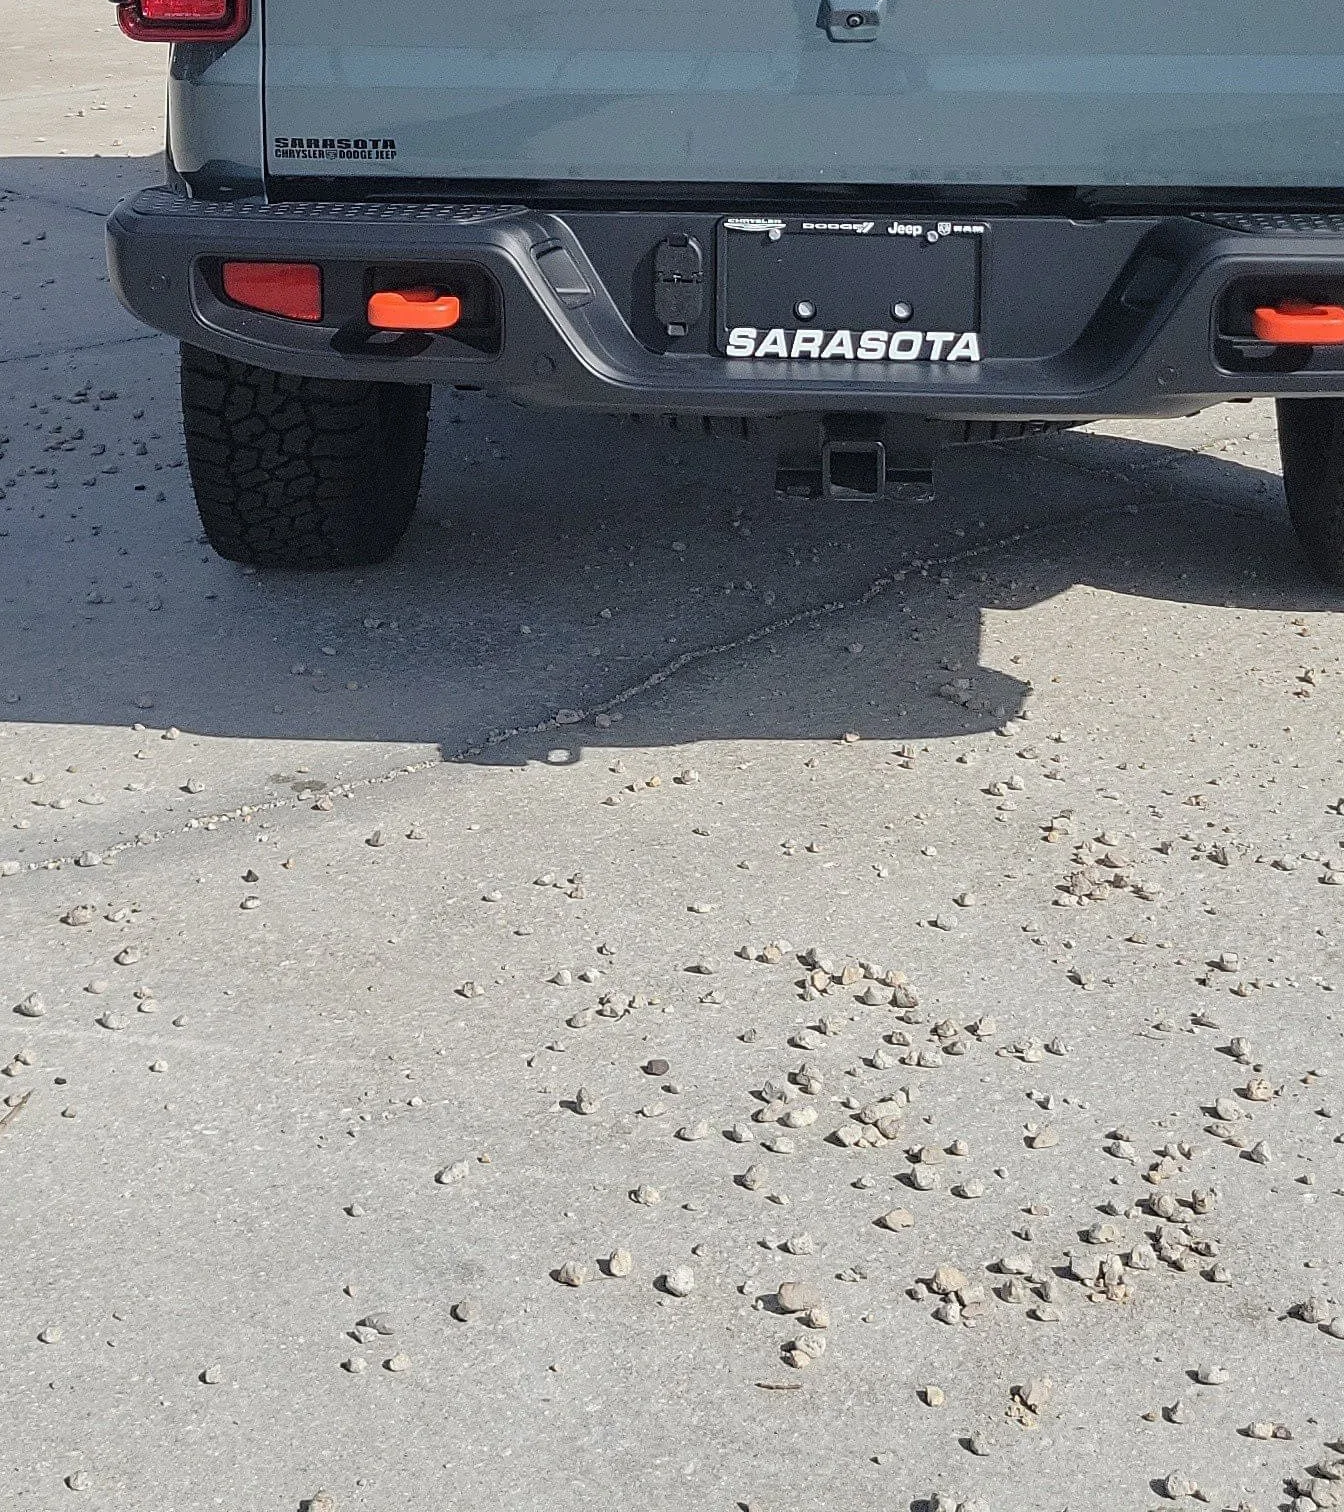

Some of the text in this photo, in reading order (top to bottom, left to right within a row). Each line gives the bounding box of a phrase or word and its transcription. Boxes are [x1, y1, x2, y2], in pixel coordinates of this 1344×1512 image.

[274, 137, 396, 149] SARASOTA
[275, 149, 397, 160] CHRYSLER DODGE JEEP
[888, 222, 922, 236] Jeep
[953, 225, 985, 233] RAM
[726, 326, 981, 361] SARASOTA
